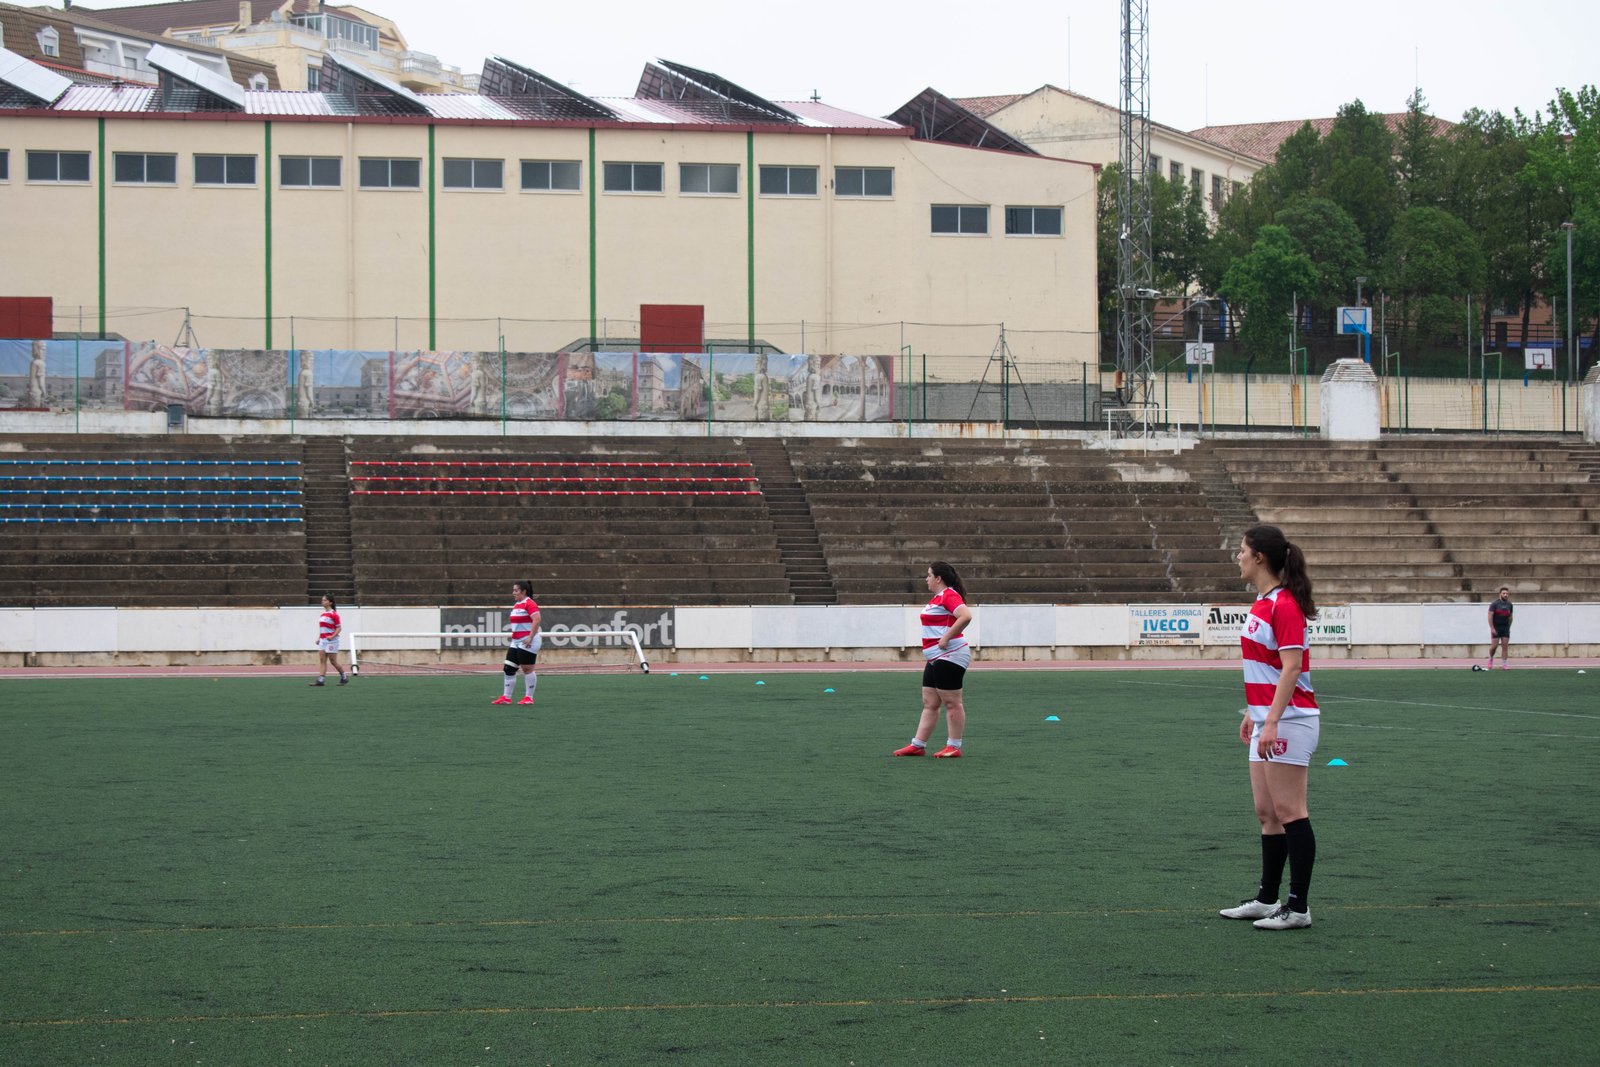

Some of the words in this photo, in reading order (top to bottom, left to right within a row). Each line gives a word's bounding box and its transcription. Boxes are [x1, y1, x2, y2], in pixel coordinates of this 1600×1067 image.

[1131, 609, 1167, 617] TALLERES
[549, 610, 673, 647] confort
[1143, 619, 1189, 632] IVECO
[1315, 625, 1321, 634] Y
[1323, 625, 1346, 634] VINOS
